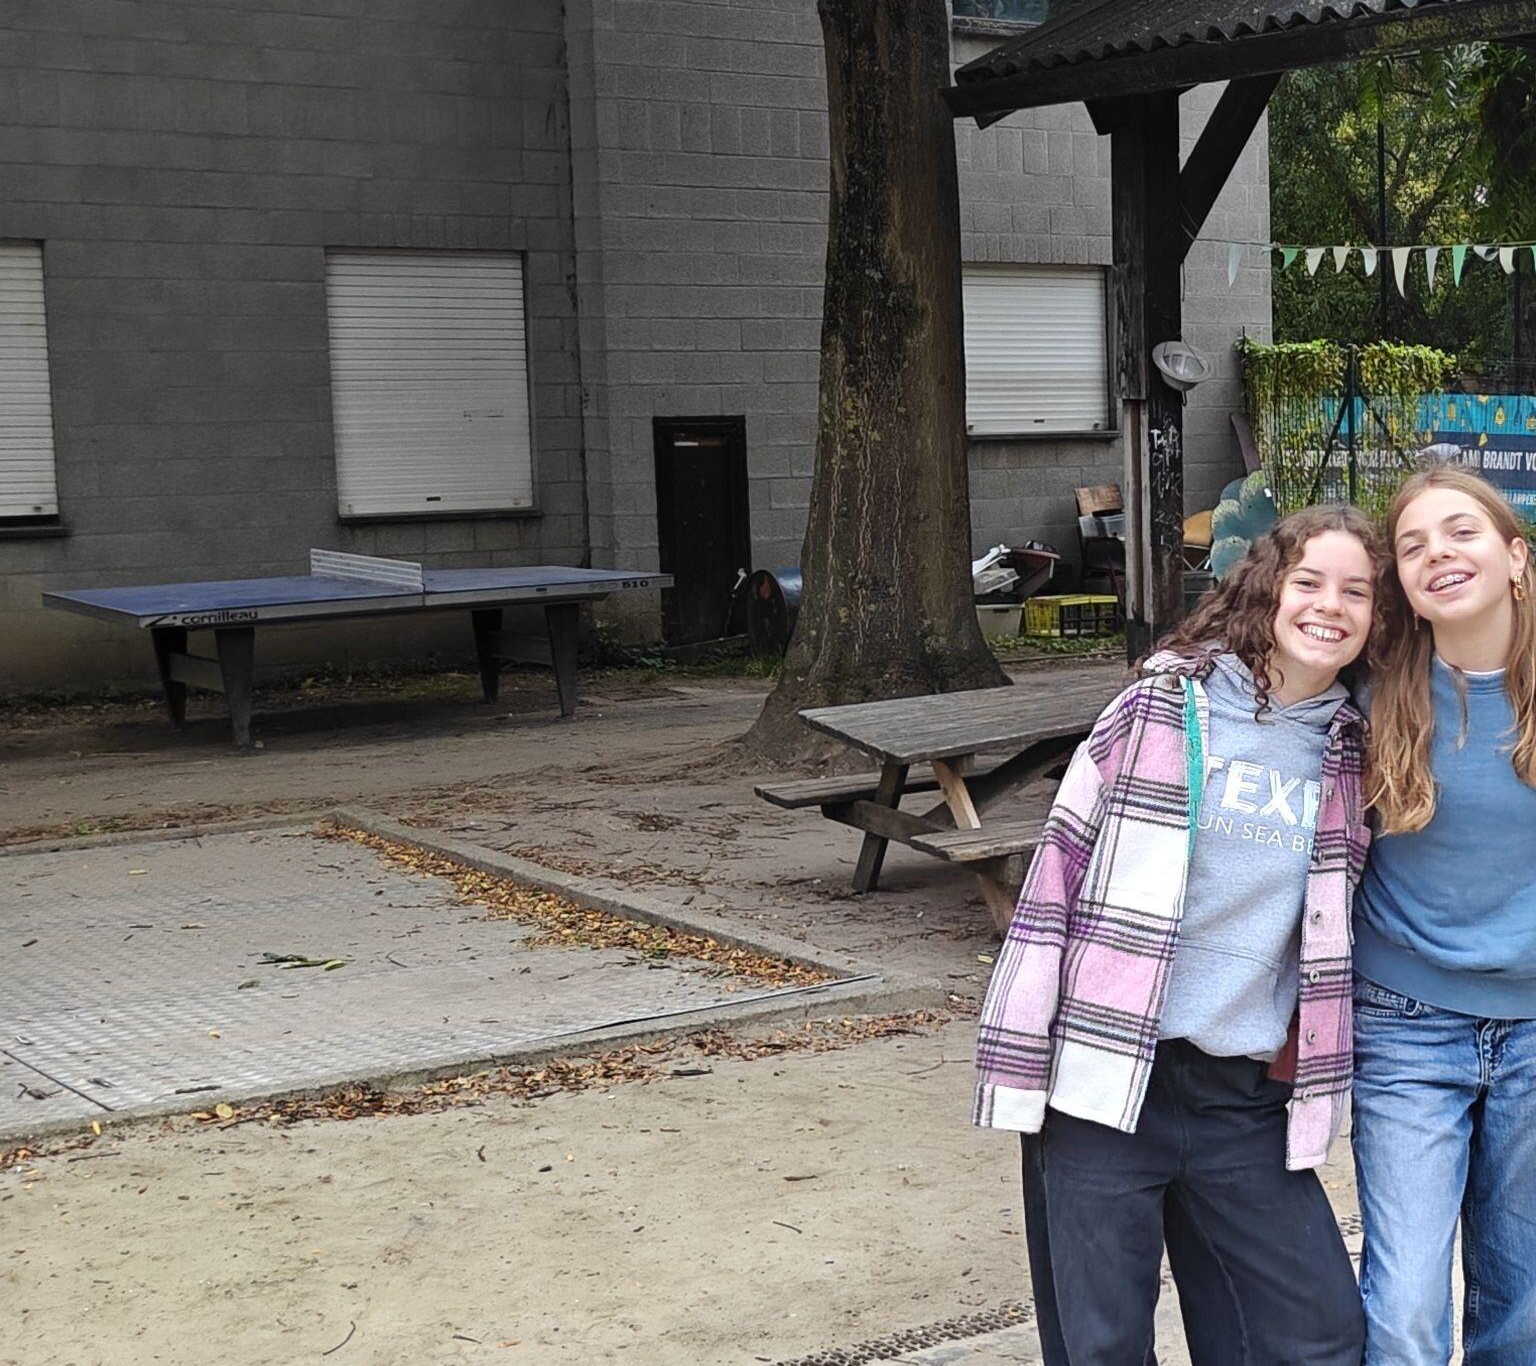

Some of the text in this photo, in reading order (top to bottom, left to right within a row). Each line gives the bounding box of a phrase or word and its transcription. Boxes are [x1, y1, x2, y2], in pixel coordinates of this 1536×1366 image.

[1483, 451, 1523, 471] BRANDT
[622, 579, 649, 589] 510
[181, 610, 258, 626] cornilleau
[1242, 822, 1284, 848] SEA
